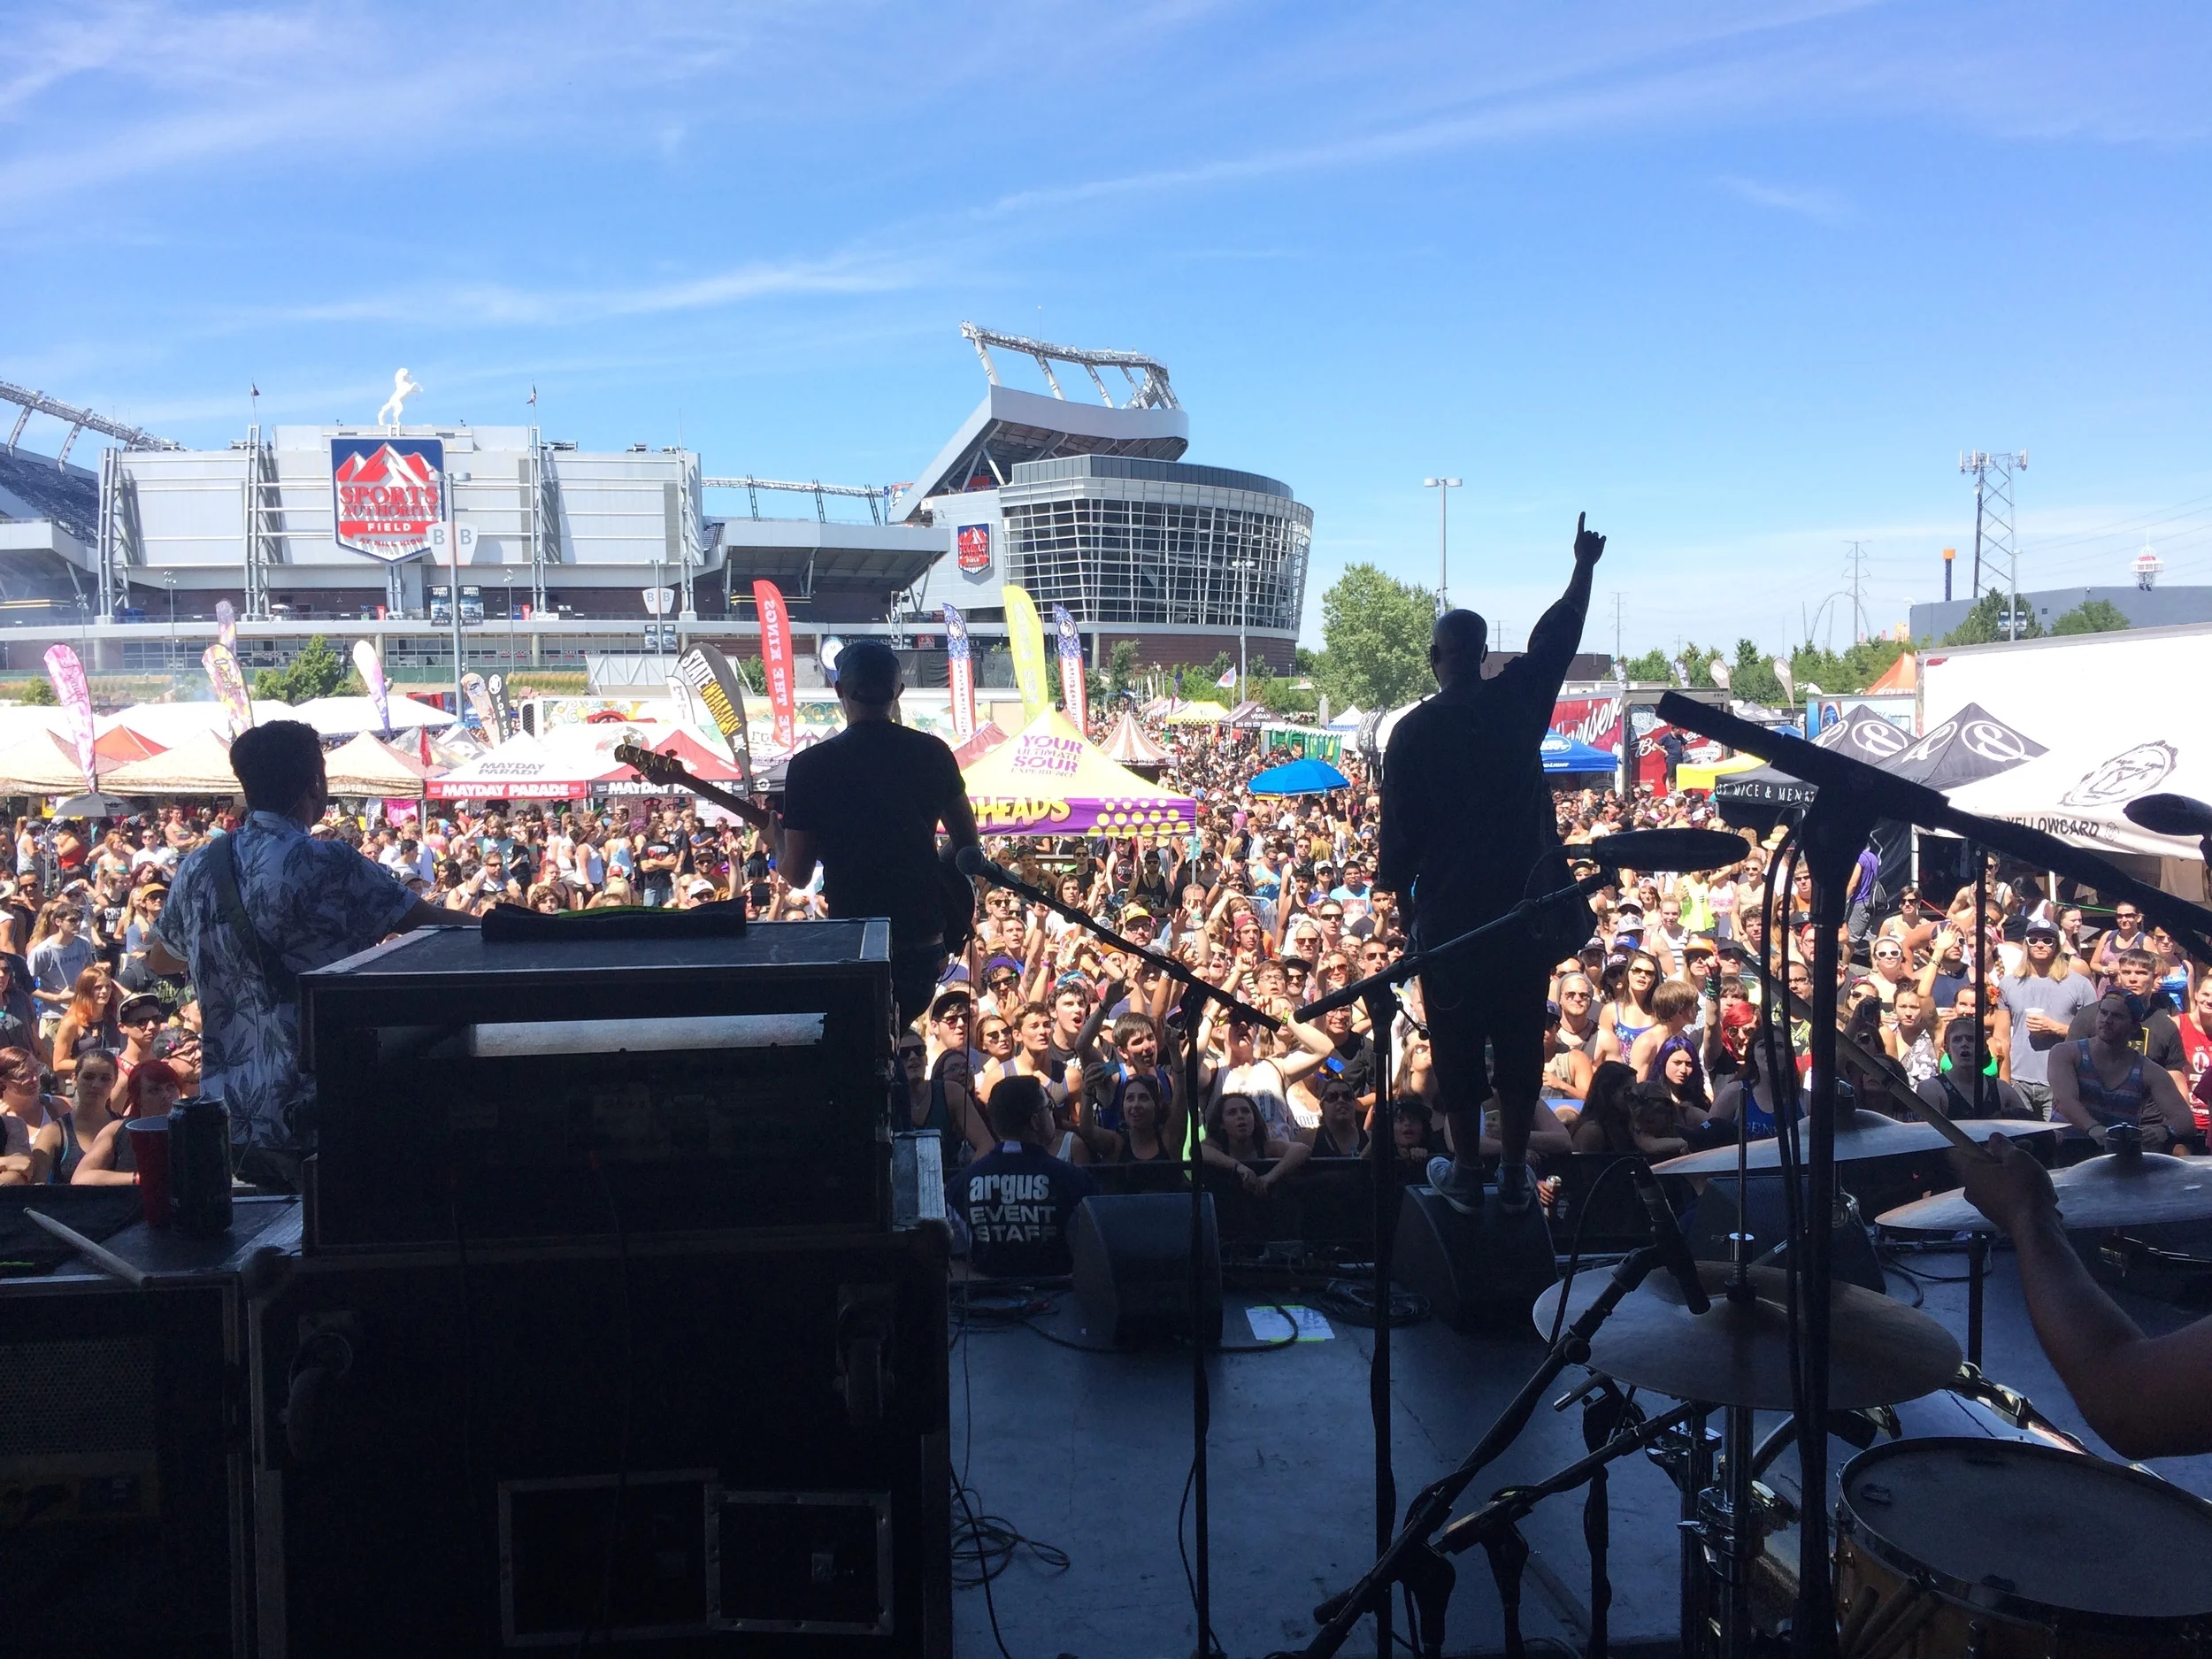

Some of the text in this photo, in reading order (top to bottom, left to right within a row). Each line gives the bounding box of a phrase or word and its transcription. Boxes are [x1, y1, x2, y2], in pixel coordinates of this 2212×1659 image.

[340, 486, 439, 505] SPORTS
[342, 504, 438, 518] AUTHORITY
[368, 523, 411, 532] FIELD
[434, 529, 472, 545] B B
[647, 592, 671, 603] B B
[681, 649, 742, 737] STATE CHAMPS
[496, 695, 506, 718] FOR
[1023, 735, 1083, 754] YOUR
[1017, 748, 1081, 762] ULTIMATE
[1012, 757, 1078, 772] SOUR
[442, 784, 506, 797] MAYDAY
[509, 783, 569, 796] PARADE
[608, 781, 669, 795] MAYDAY
[672, 781, 733, 795] PADE
[1765, 786, 1771, 799] &
[972, 796, 1070, 828] HEADS
[969, 1174, 1049, 1203] argus
[970, 1205, 1056, 1225] EVENT
[975, 1225, 1057, 1242] STAFF
